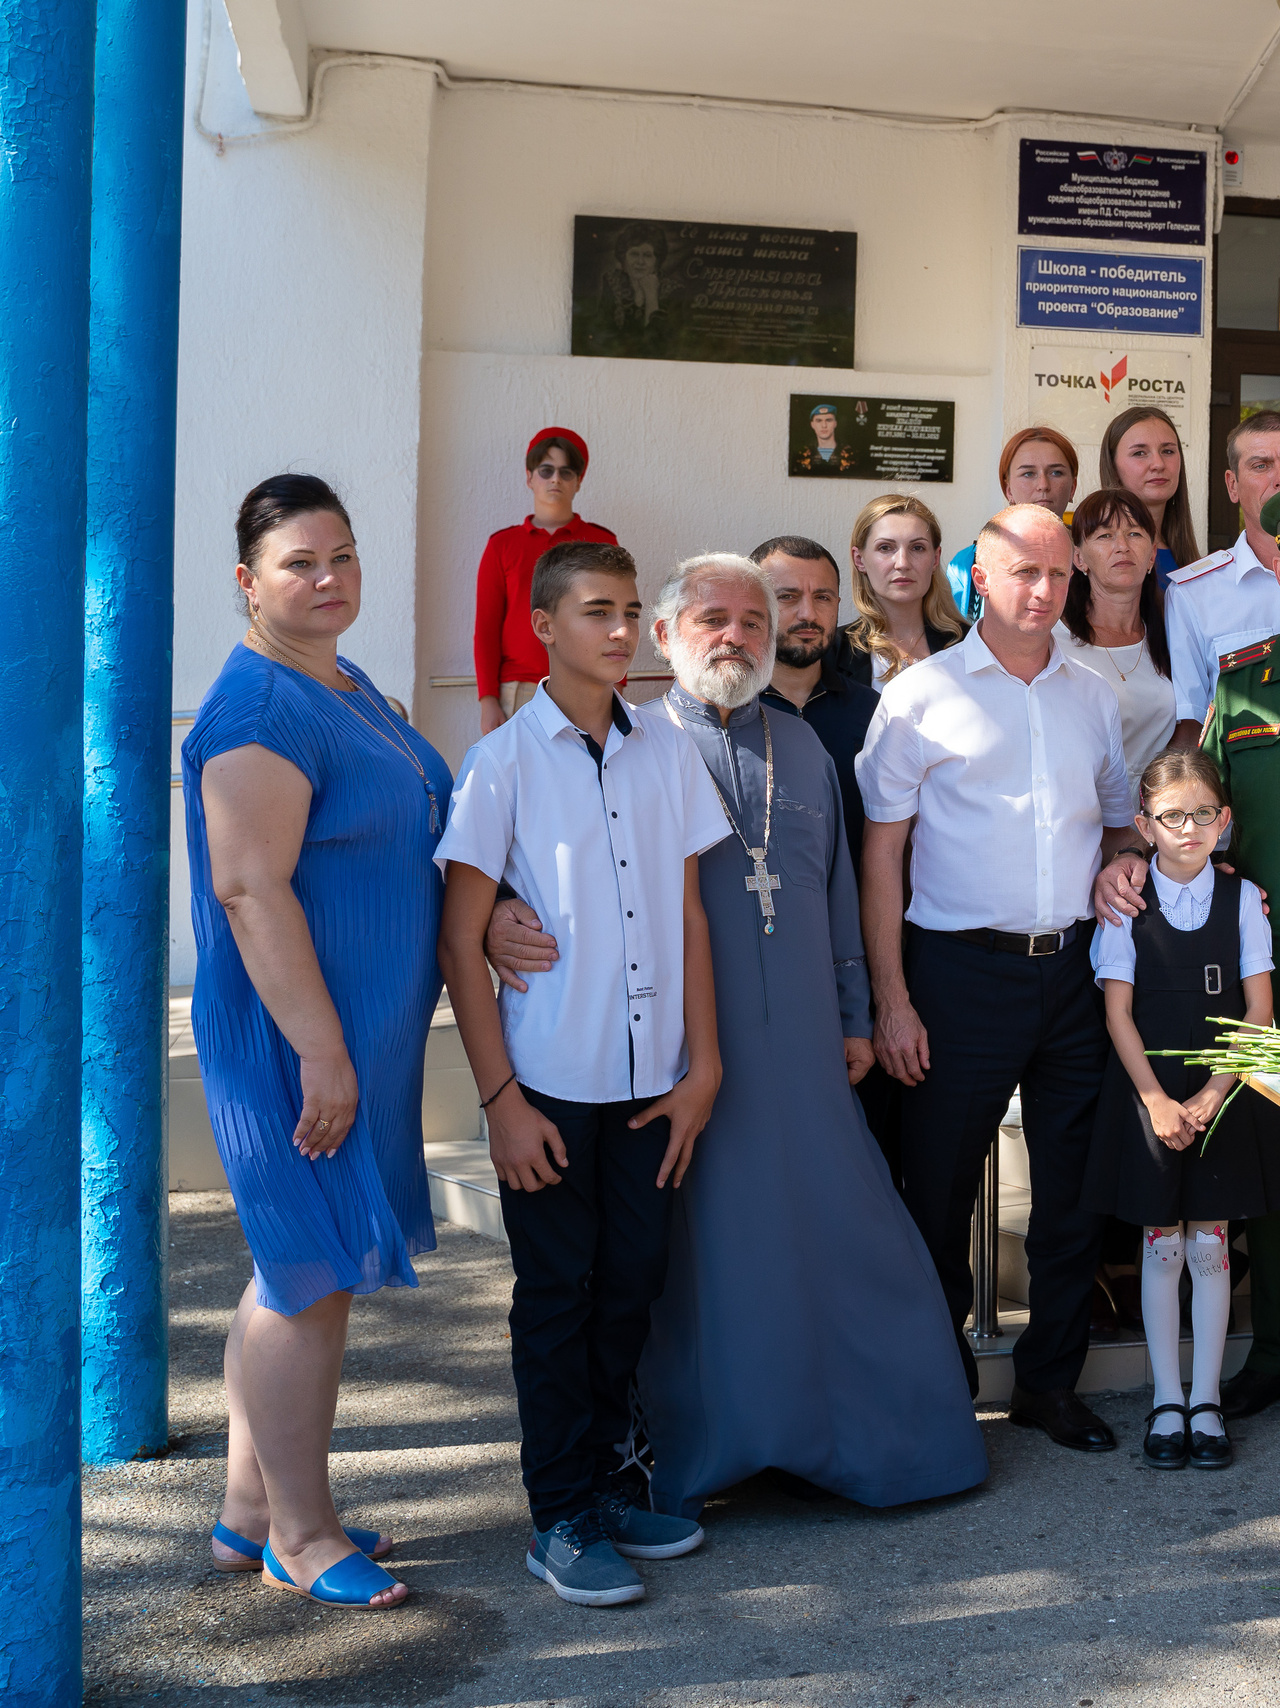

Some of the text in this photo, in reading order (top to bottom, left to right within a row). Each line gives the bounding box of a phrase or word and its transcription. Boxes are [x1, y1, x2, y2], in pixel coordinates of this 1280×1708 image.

[1035, 149, 1070, 157] Российская
[1156, 156, 1200, 165] Краснодарский
[1071, 172, 1159, 187] Муниципальное бюджетное
[1059, 183, 1170, 198] общеобразовательное учреждение
[1048, 195, 1075, 204] средняя
[1075, 195, 1147, 207] общеобразовательная
[1168, 200, 1177, 209] №
[1177, 200, 1182, 209] 7
[1078, 207, 1099, 215] имени
[1028, 216, 1201, 232] муниципального образования город-курорт Геленджик
[708, 231, 749, 241] имя
[759, 233, 816, 246] носит
[693, 246, 810, 261] наша школа
[686, 258, 822, 287] Стерняева
[1038, 259, 1087, 277] Школа
[1099, 265, 1187, 283] победитель
[706, 281, 813, 300] Прасковья
[1025, 282, 1198, 301] приоритетного национального
[690, 294, 819, 316] Дмитриевна
[1038, 301, 1088, 314] проекта
[1034, 373, 1186, 393] ТОЧКА РОСТА
[1190, 1251, 1212, 1263] hello
[1197, 1264, 1222, 1277] kitty
